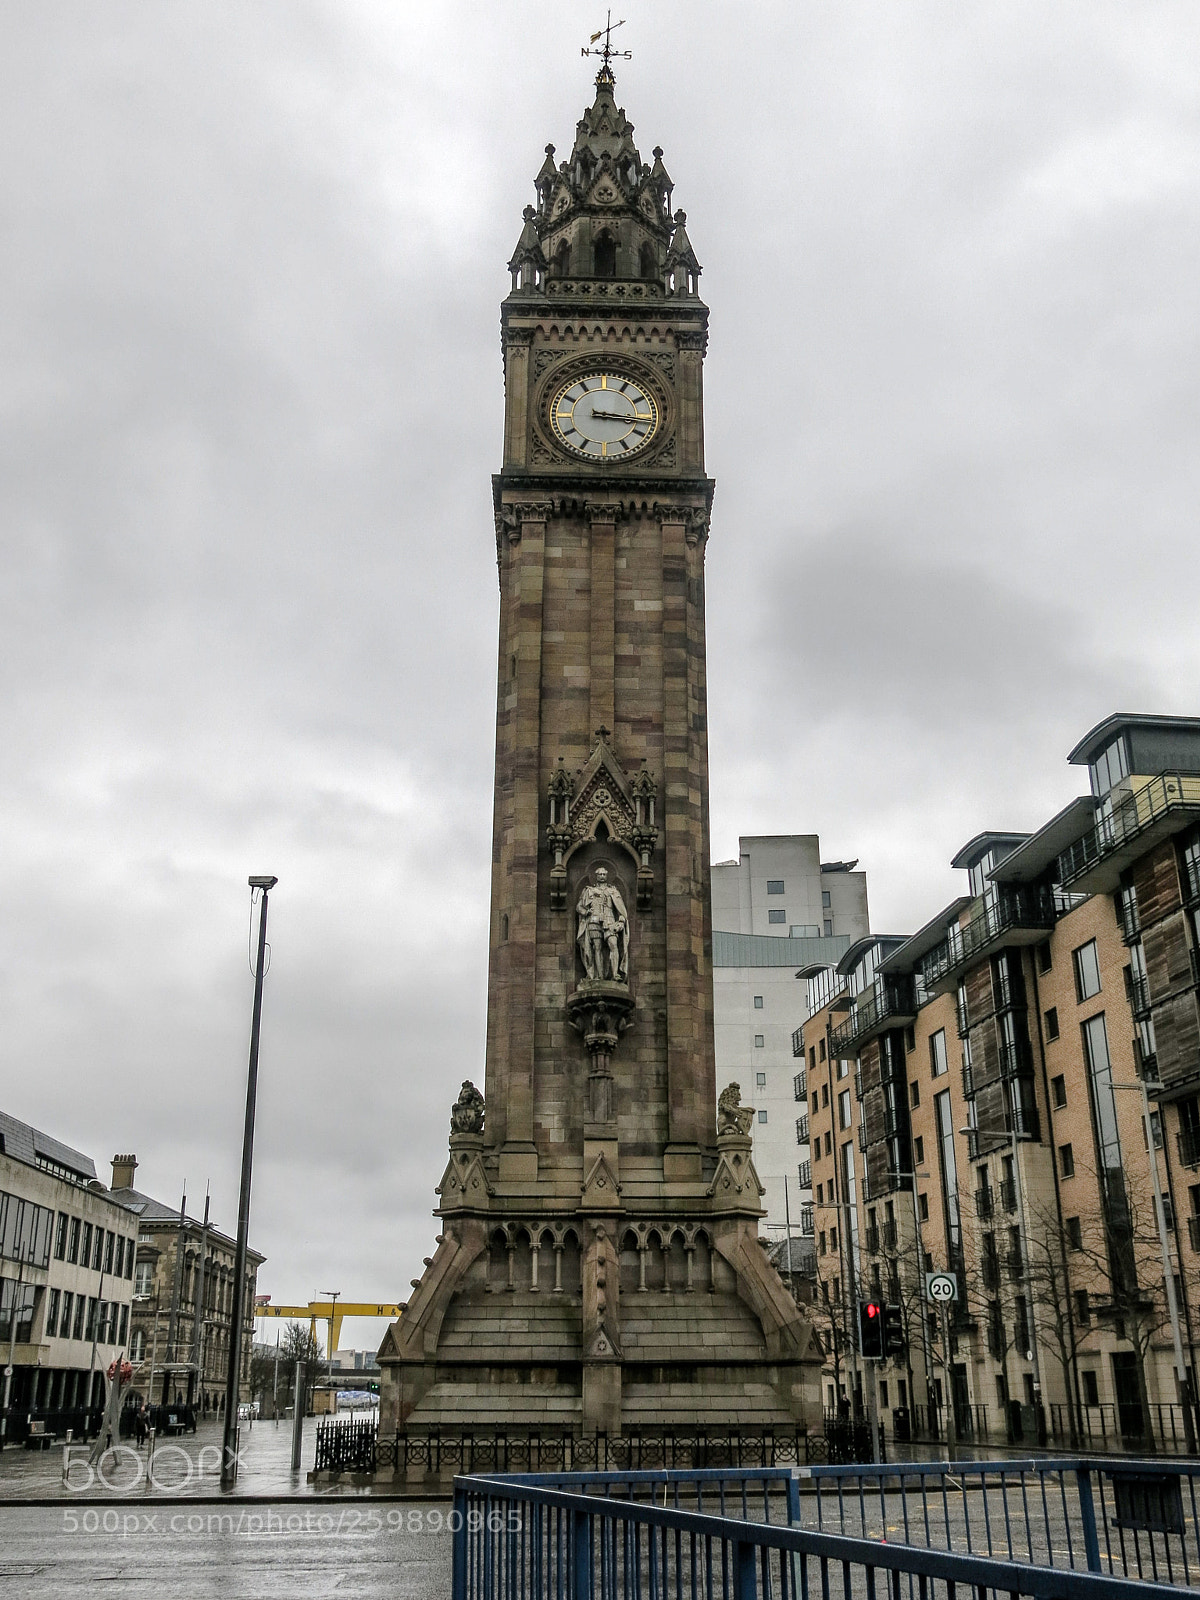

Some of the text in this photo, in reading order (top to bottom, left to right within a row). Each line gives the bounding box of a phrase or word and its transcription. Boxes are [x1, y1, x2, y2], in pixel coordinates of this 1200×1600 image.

[581, 48, 589, 57] N
[624, 51, 632, 60] S
[933, 1284, 951, 1295] 20
[274, 1308, 281, 1316] W
[377, 1305, 384, 1315] H
